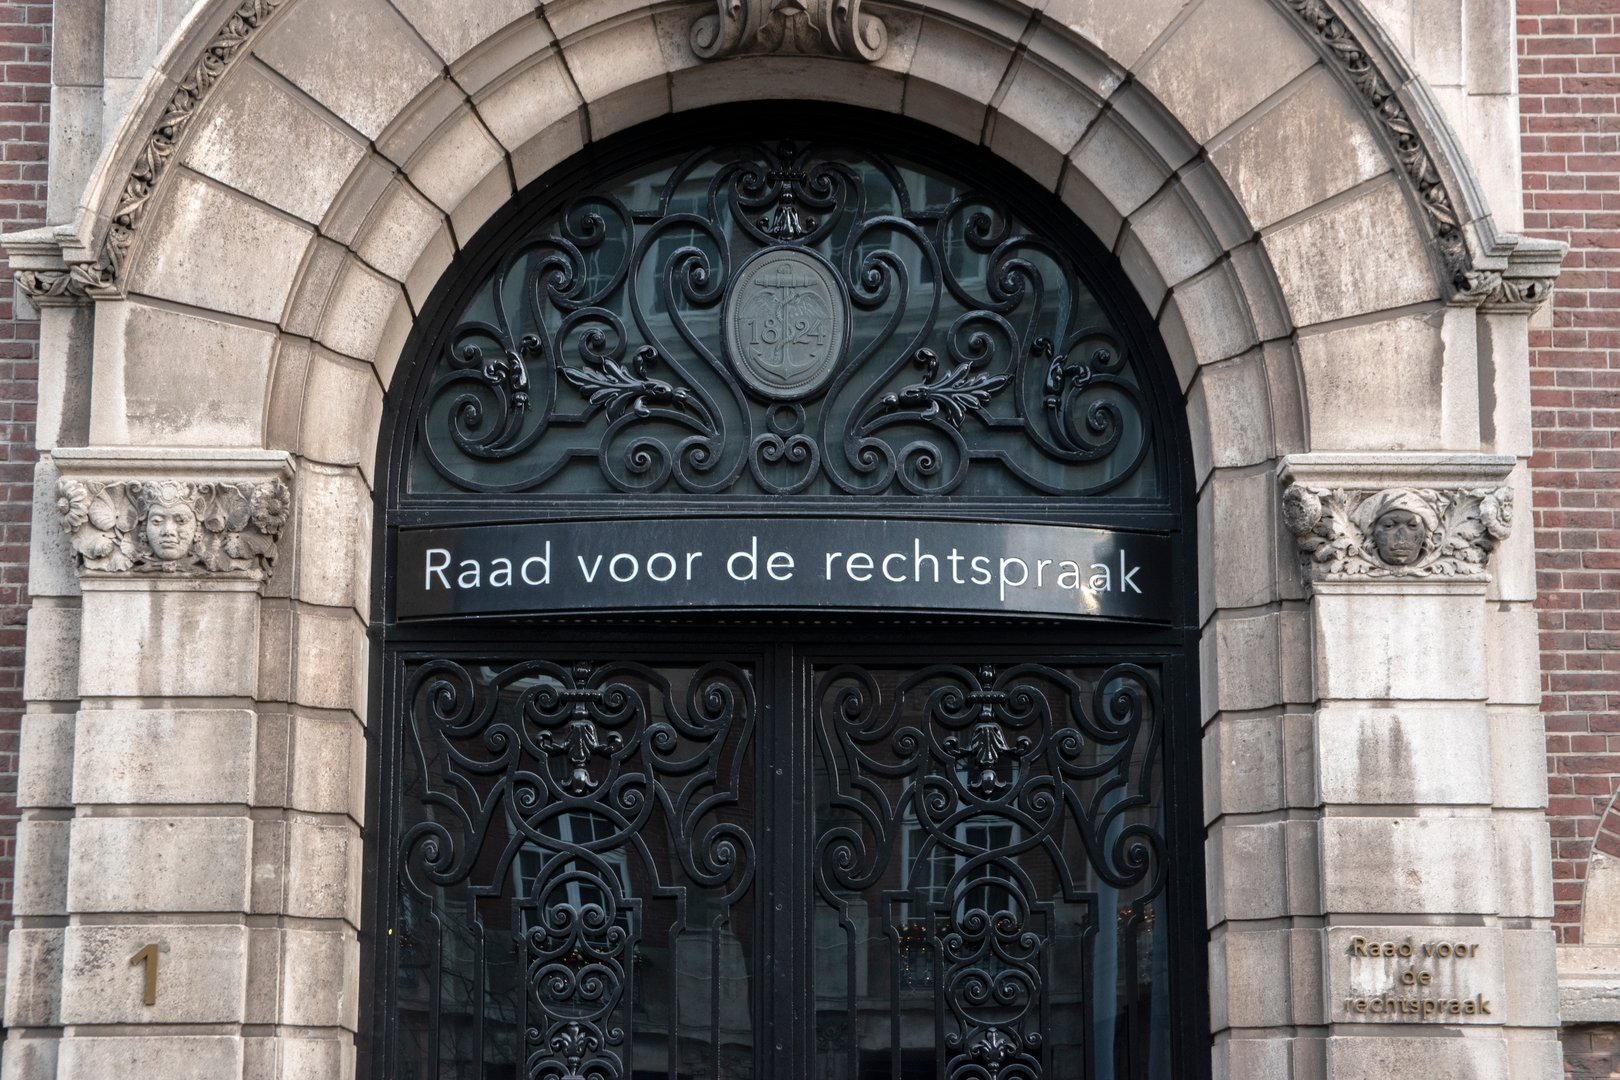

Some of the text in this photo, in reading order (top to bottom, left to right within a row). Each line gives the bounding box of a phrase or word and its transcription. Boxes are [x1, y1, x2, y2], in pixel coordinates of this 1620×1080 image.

[424, 536, 1142, 601] Raad voor de rechtspraak
[1351, 936, 1479, 958] Raad voor
[130, 943, 158, 1006] 1
[1402, 965, 1432, 986] de
[1345, 992, 1491, 1019] rechtspraak
